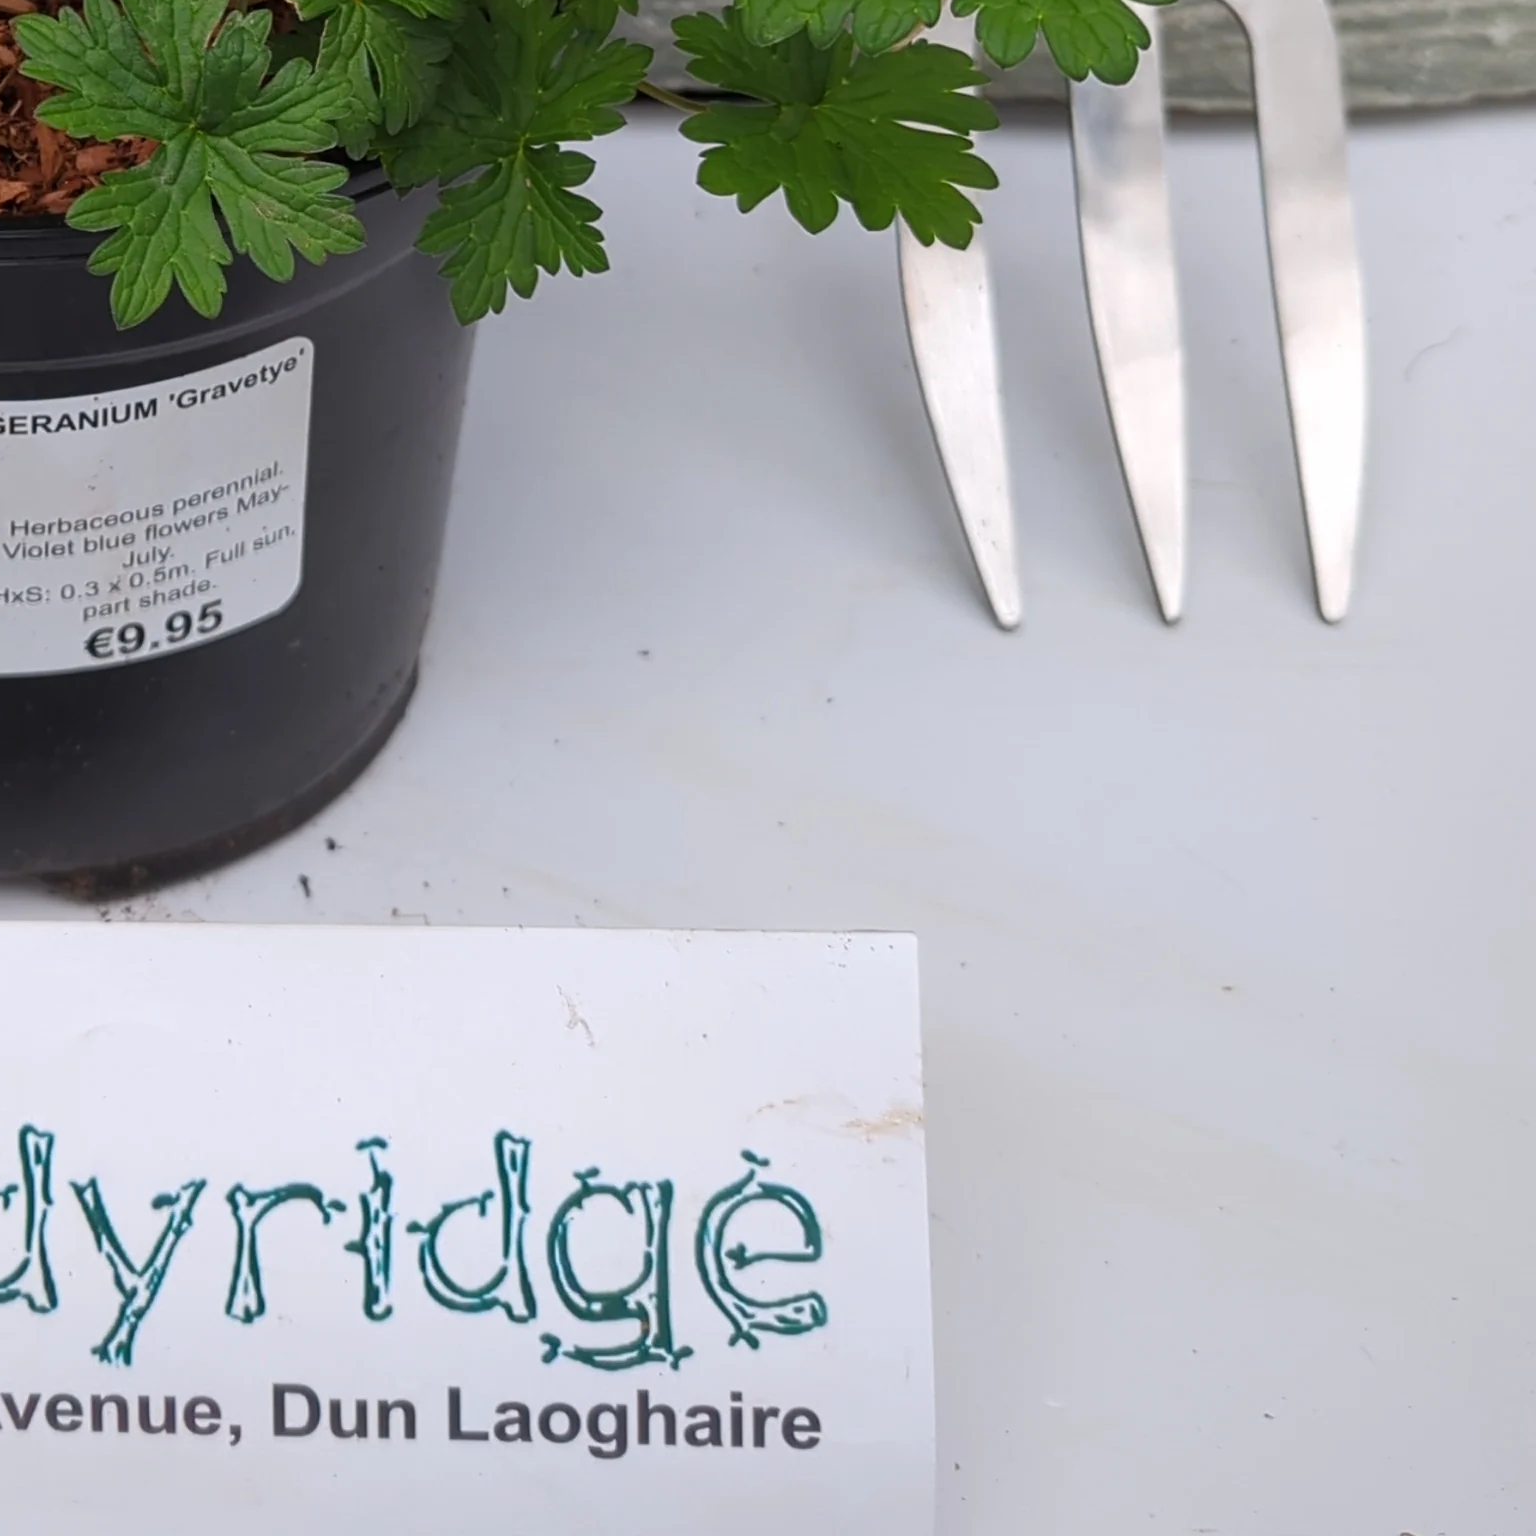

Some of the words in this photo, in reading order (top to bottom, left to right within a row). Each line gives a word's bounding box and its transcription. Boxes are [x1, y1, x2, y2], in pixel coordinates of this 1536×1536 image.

[168, 347, 306, 410] 'Gravetye'
[2, 537, 75, 560] Violet
[83, 531, 136, 554] blue
[145, 506, 229, 542] flowers
[236, 483, 290, 514] May-
[10, 502, 164, 537] Herbaceous
[172, 461, 284, 516] perennial.
[60, 580, 100, 601] 0.3
[108, 577, 122, 594] x
[129, 563, 196, 589] 0.5m.
[205, 541, 245, 569] Full
[122, 546, 175, 570] July.
[83, 598, 131, 623] part
[139, 577, 218, 609] shade.
[85, 598, 224, 660] €9.95
[270, 1382, 418, 1441] Dun
[447, 1385, 823, 1460] Laoghaire
